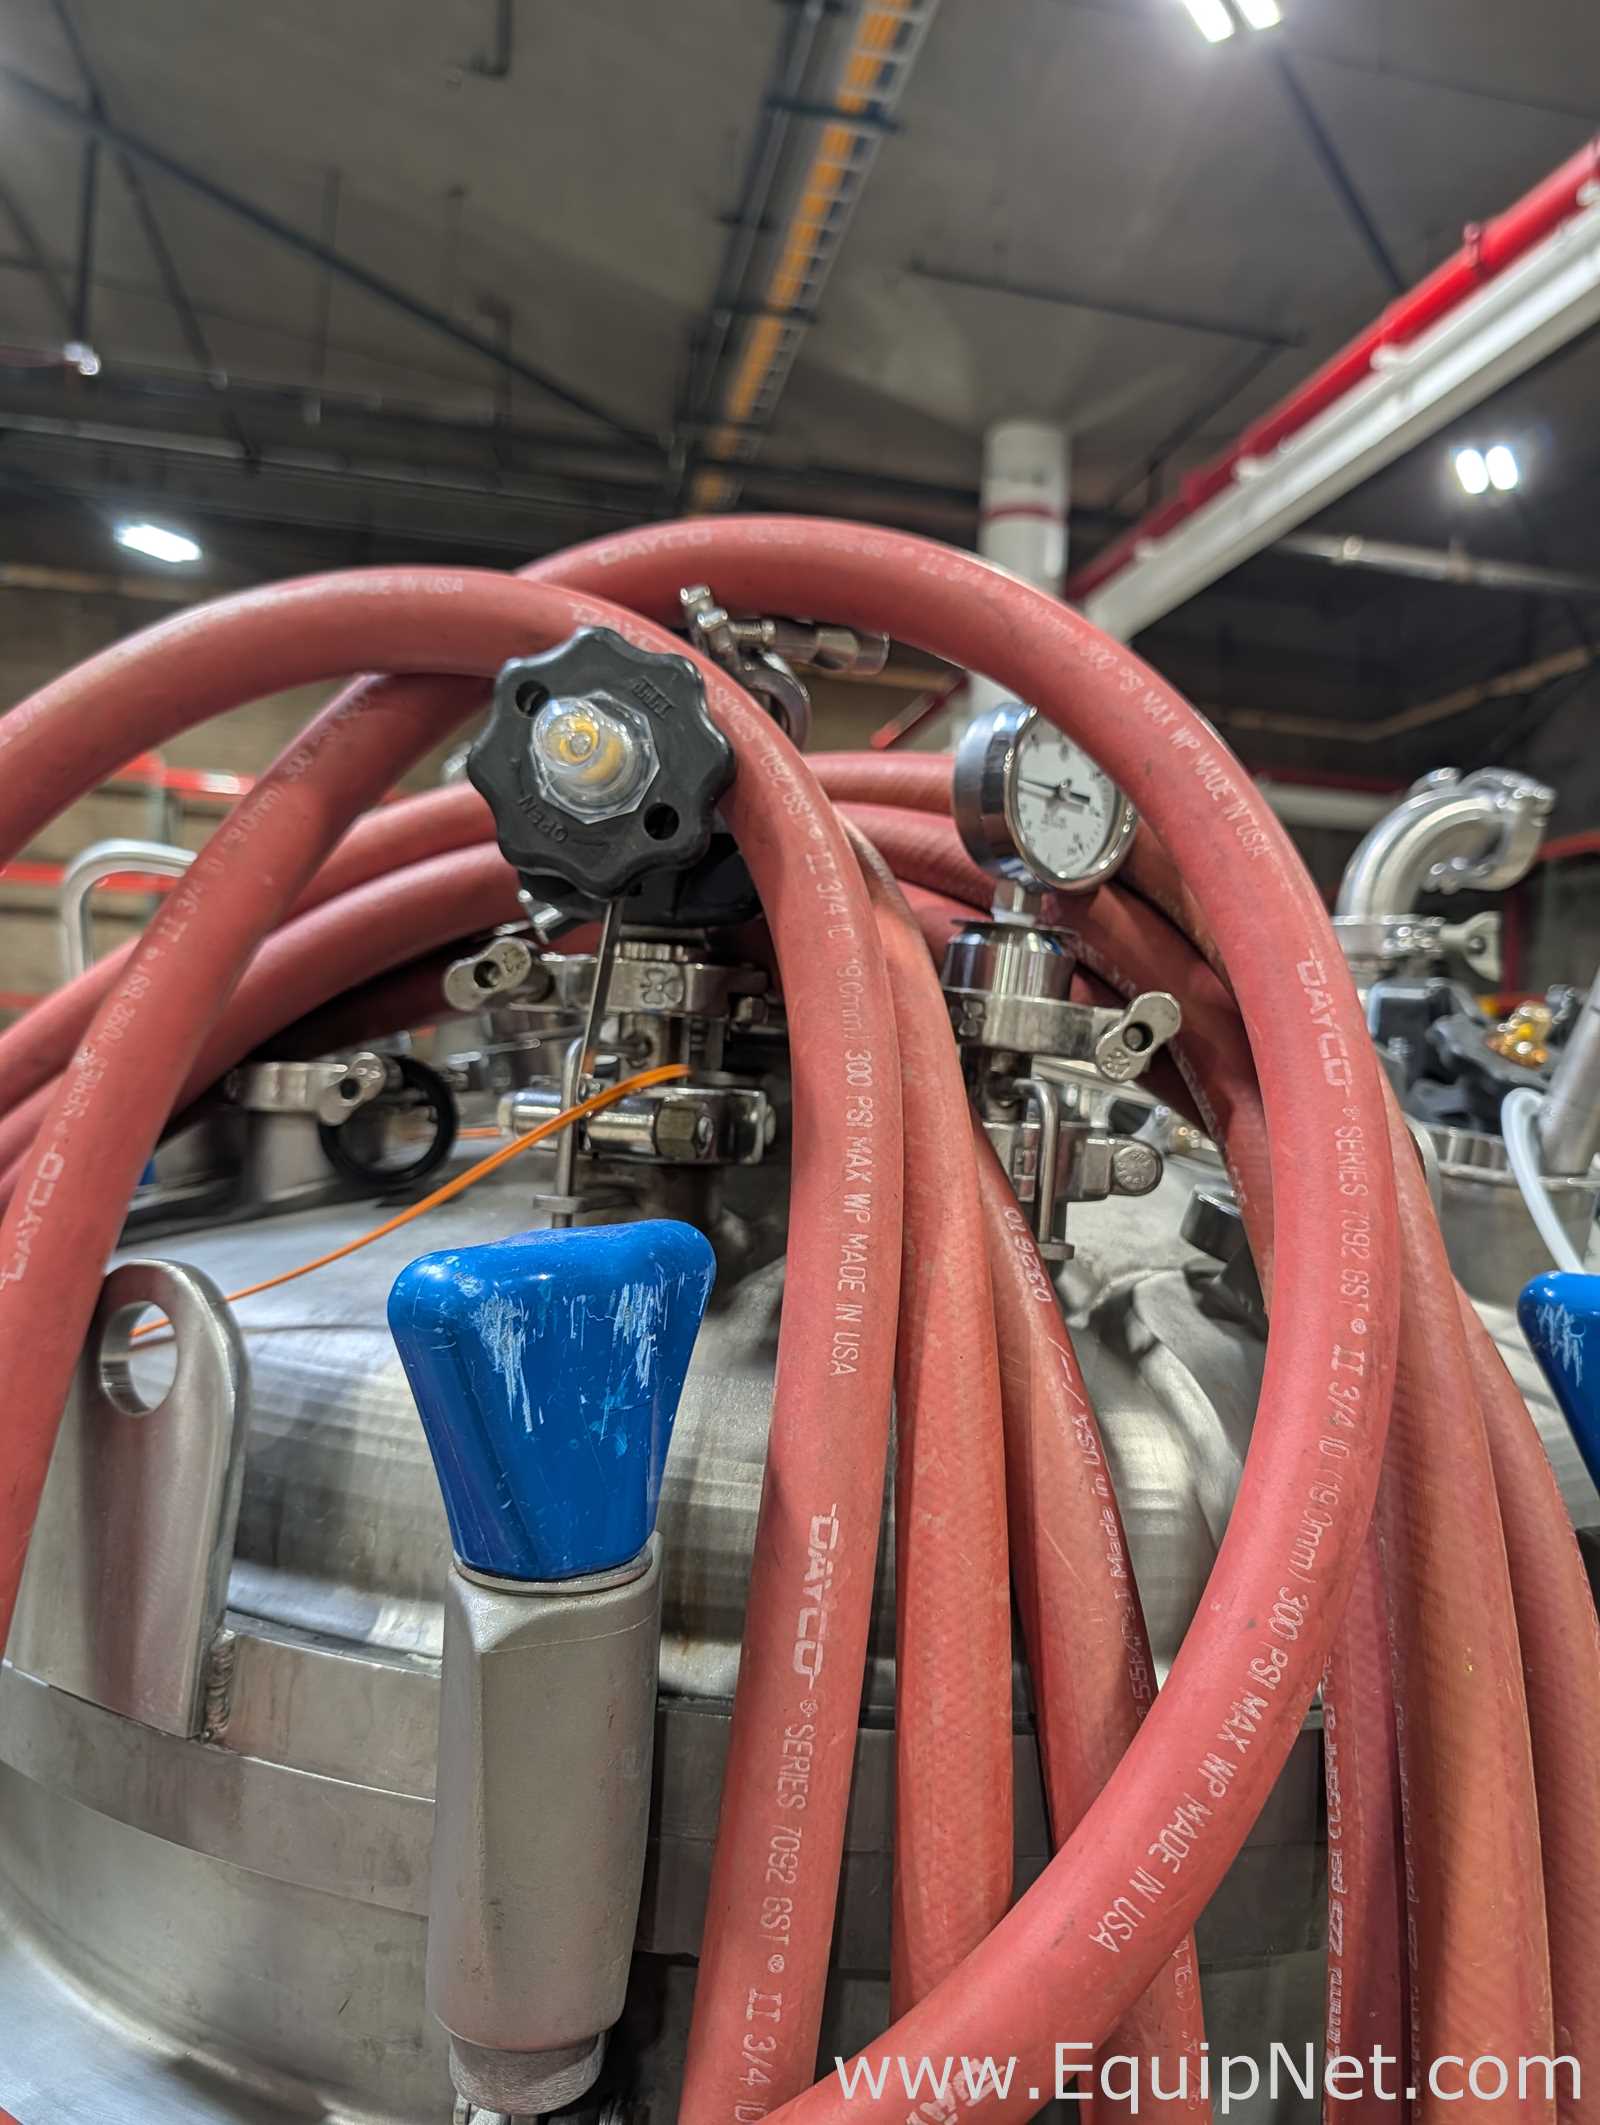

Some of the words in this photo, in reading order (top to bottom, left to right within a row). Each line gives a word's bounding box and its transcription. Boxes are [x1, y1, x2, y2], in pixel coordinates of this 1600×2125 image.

[715, 686, 766, 744] SERIES
[1142, 690, 1179, 729] MAX
[1168, 726, 1201, 752] WP
[1189, 752, 1238, 802] MADE
[1235, 811, 1273, 861] USA
[815, 880, 850, 918] 3/4
[1296, 947, 1353, 1099] DAYCO
[844, 1049, 873, 1087] 300
[846, 1095, 874, 1128] PSI
[844, 1135, 874, 1184] MAX
[1334, 1125, 1370, 1198] SERIES
[0, 1142, 65, 1290] DAYCO
[843, 1192, 872, 1225] WP
[1336, 1207, 1371, 1259] 7092
[836, 1231, 870, 1294] MADE
[835, 1301, 863, 1324] IN
[1338, 1267, 1371, 1313] GST
[830, 1331, 860, 1377] USA
[1325, 1381, 1361, 1430] 3/4
[1070, 1412, 1101, 1467] USA
[1318, 1434, 1351, 1460] ID
[1090, 1473, 1112, 1498] in
[1098, 1505, 1129, 1578] Made
[793, 1503, 840, 1690] DAYCO
[1268, 1585, 1310, 1641] 300
[1247, 1640, 1289, 1692] PSI
[1215, 1688, 1270, 1755] MAX
[776, 1722, 817, 1811] SERIES
[1198, 1751, 1238, 1799] WP
[764, 1825, 804, 1886] 7092
[1148, 1792, 1215, 1874] MADE
[1128, 1866, 1166, 1904] IN
[758, 1896, 794, 1946] GST
[1088, 1896, 1147, 1953] USA
[739, 2033, 778, 2087] 3/4
